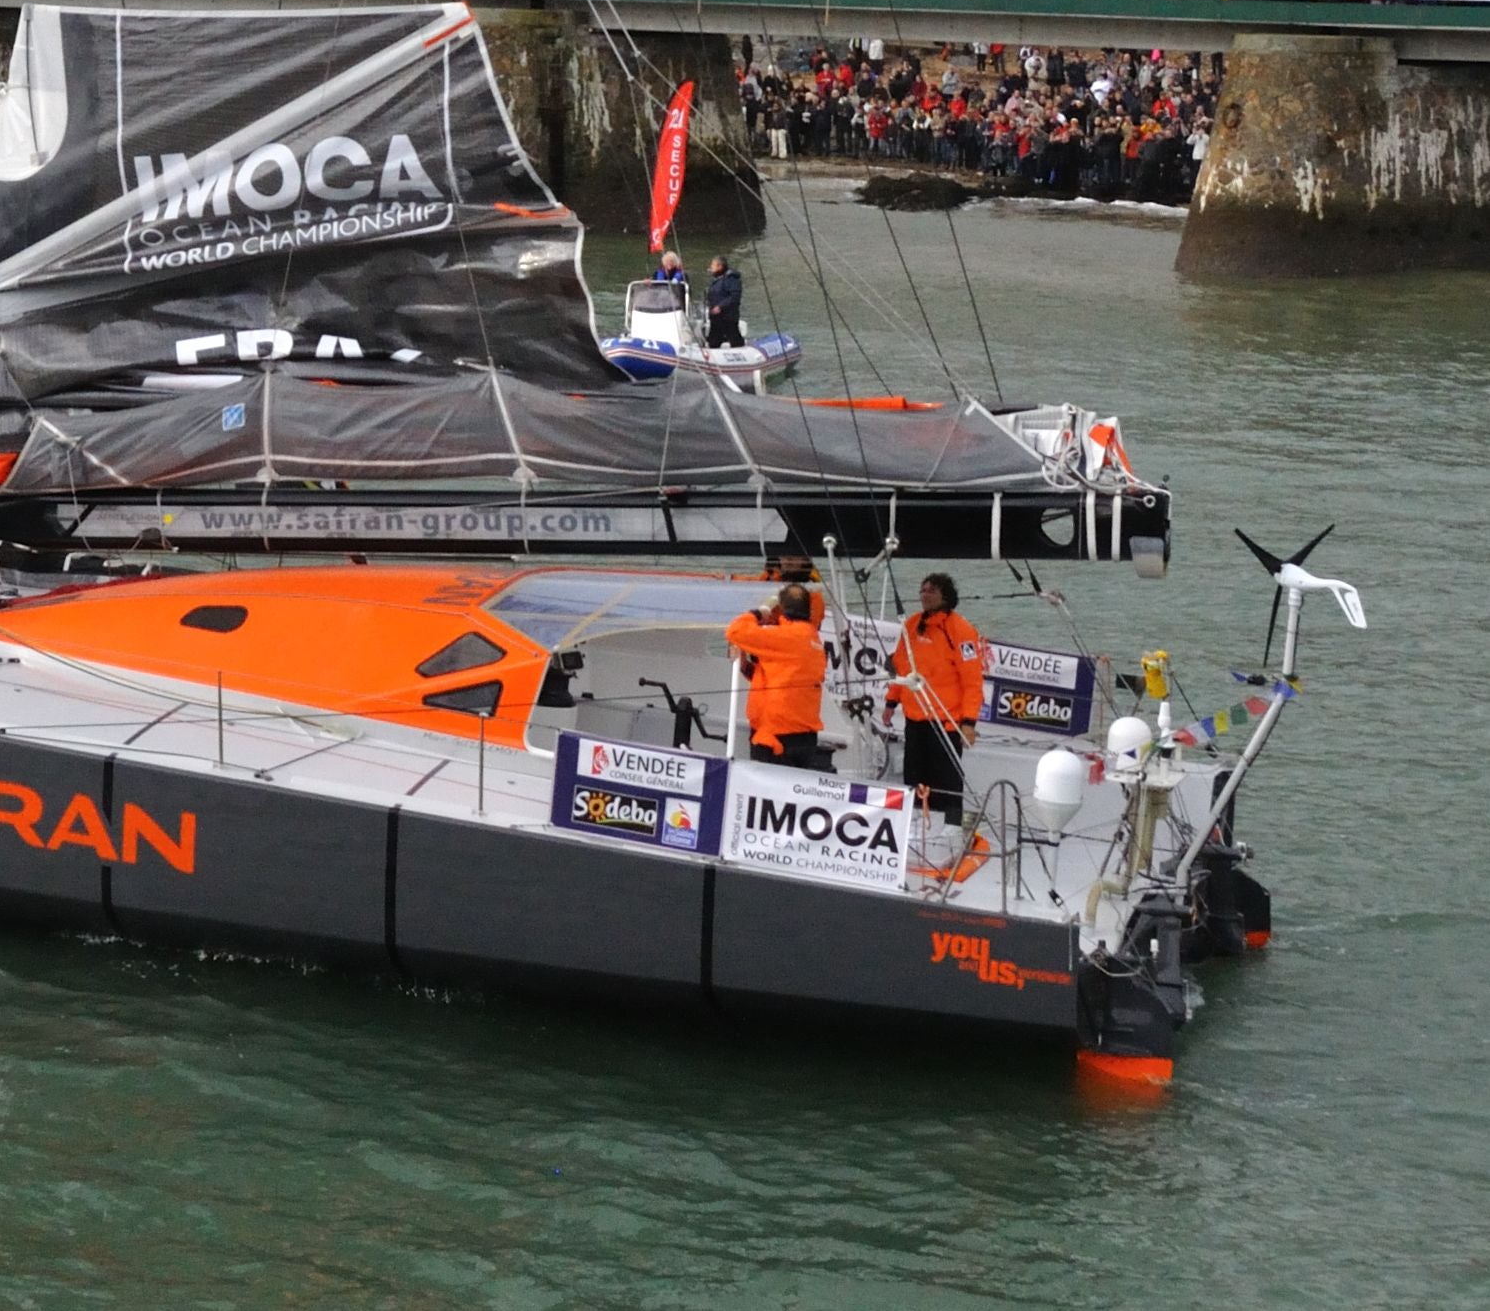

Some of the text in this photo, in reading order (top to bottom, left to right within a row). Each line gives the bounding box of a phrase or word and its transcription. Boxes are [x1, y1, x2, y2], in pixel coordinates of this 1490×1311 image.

[669, 108, 686, 129] 21
[133, 134, 445, 222] IMOCA
[139, 213, 273, 246] OCEAN
[141, 203, 439, 270] WORLD CHAMPIONSHIP
[199, 506, 612, 538] www.safran-group.com
[998, 648, 1062, 675] VENDÉE
[997, 691, 1071, 721] Sodebo
[609, 769, 684, 790] CONSEIL GÉNÉRAL
[612, 747, 687, 779] VENDÉE
[792, 783, 846, 801] Guillemot
[818, 777, 847, 790] Marc
[572, 791, 657, 824] Sodebo
[730, 793, 744, 856] official event
[746, 795, 899, 854] IMOCA
[743, 848, 898, 883] WORLD CHAMPIONSHIP
[744, 832, 899, 869] OCEAN RACING
[930, 931, 991, 964] you
